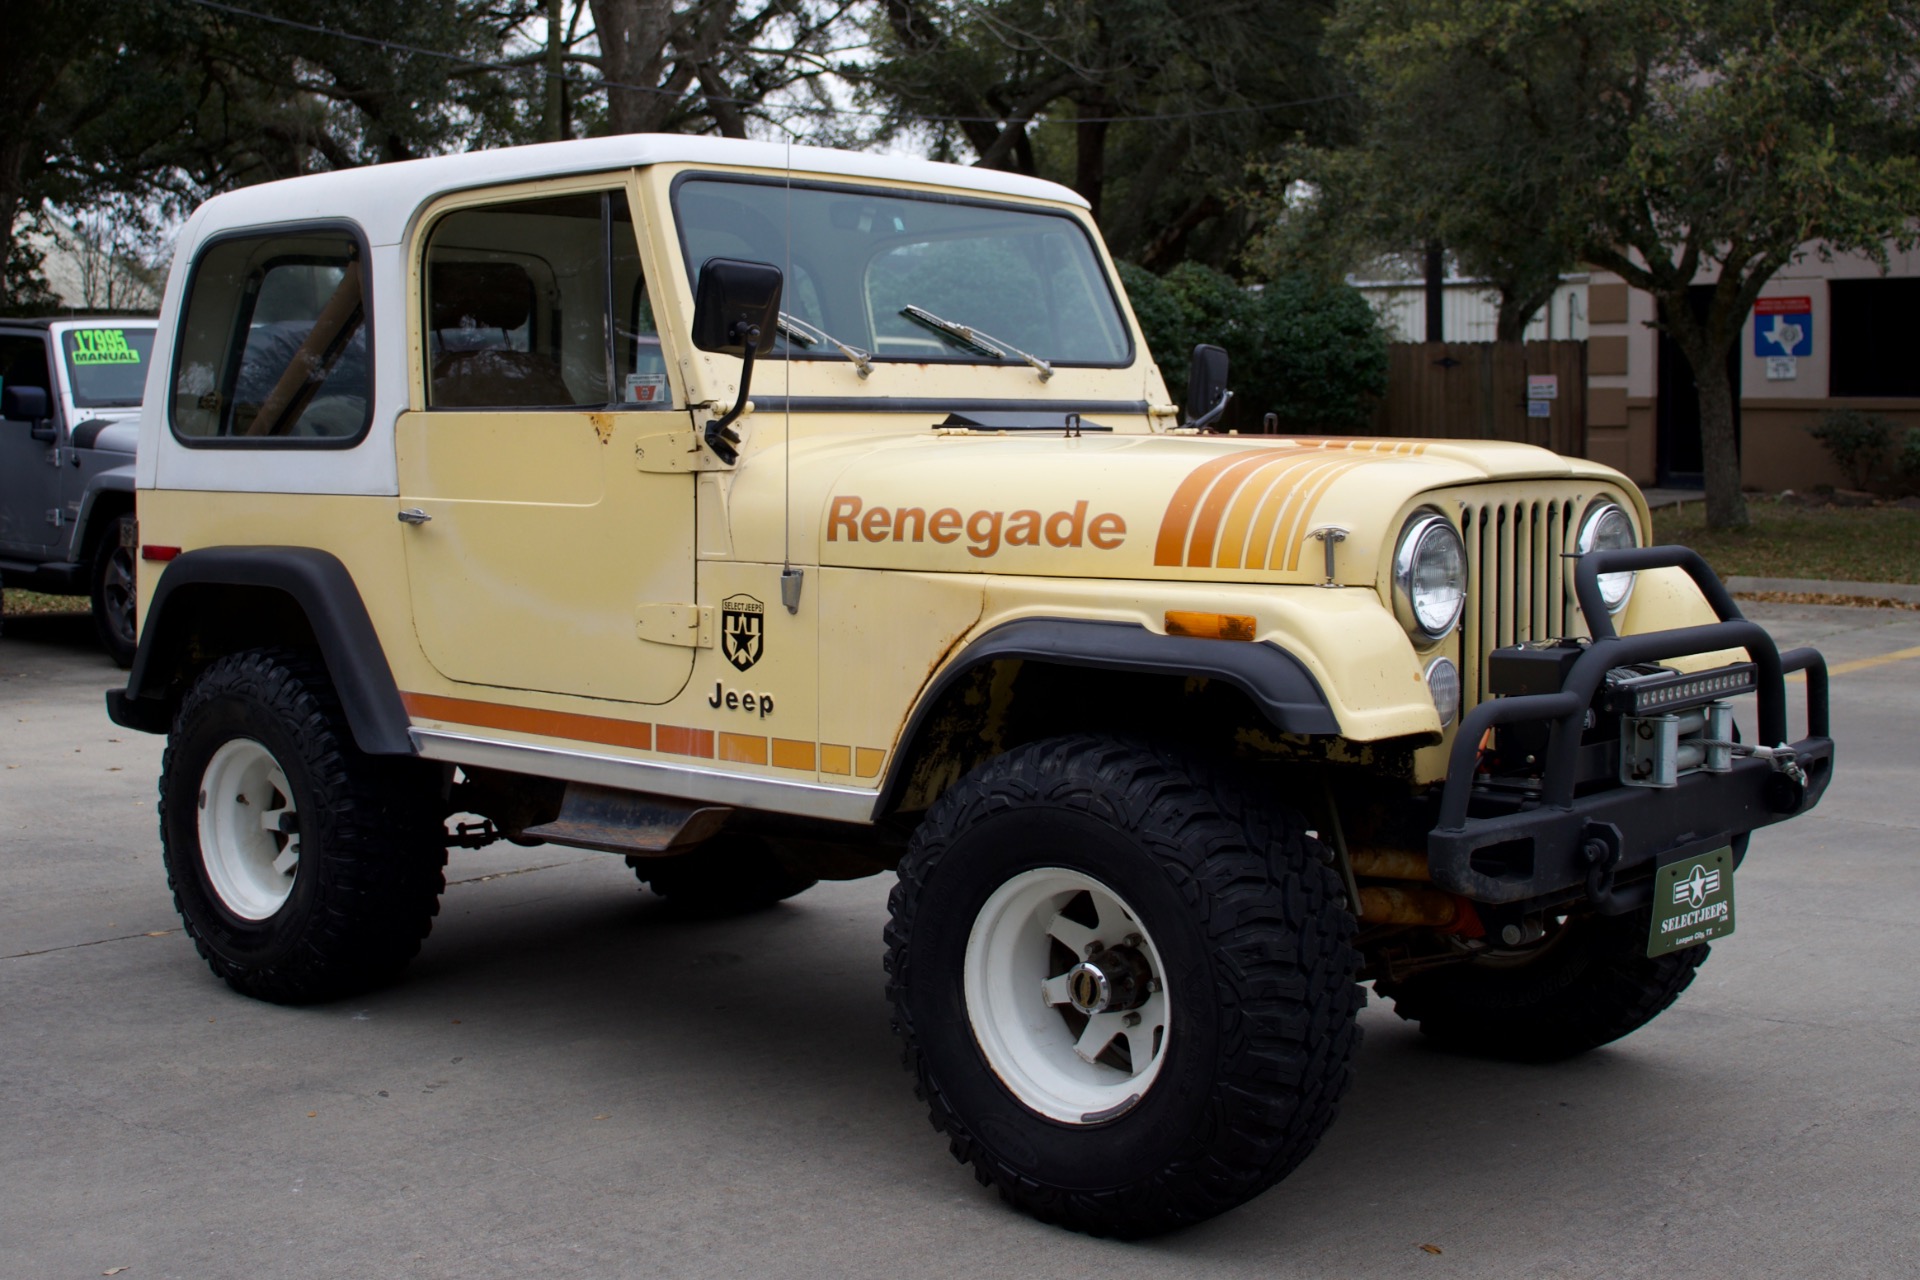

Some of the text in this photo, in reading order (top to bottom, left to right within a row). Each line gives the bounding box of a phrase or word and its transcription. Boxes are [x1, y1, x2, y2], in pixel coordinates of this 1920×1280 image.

[74, 329, 128, 351] 17995
[75, 352, 137, 361] MANUAL
[826, 495, 1127, 558] Renegade
[708, 681, 774, 718] Jeep
[1661, 901, 1728, 933] SELECTJEEPS
[1706, 927, 1713, 936] TX
